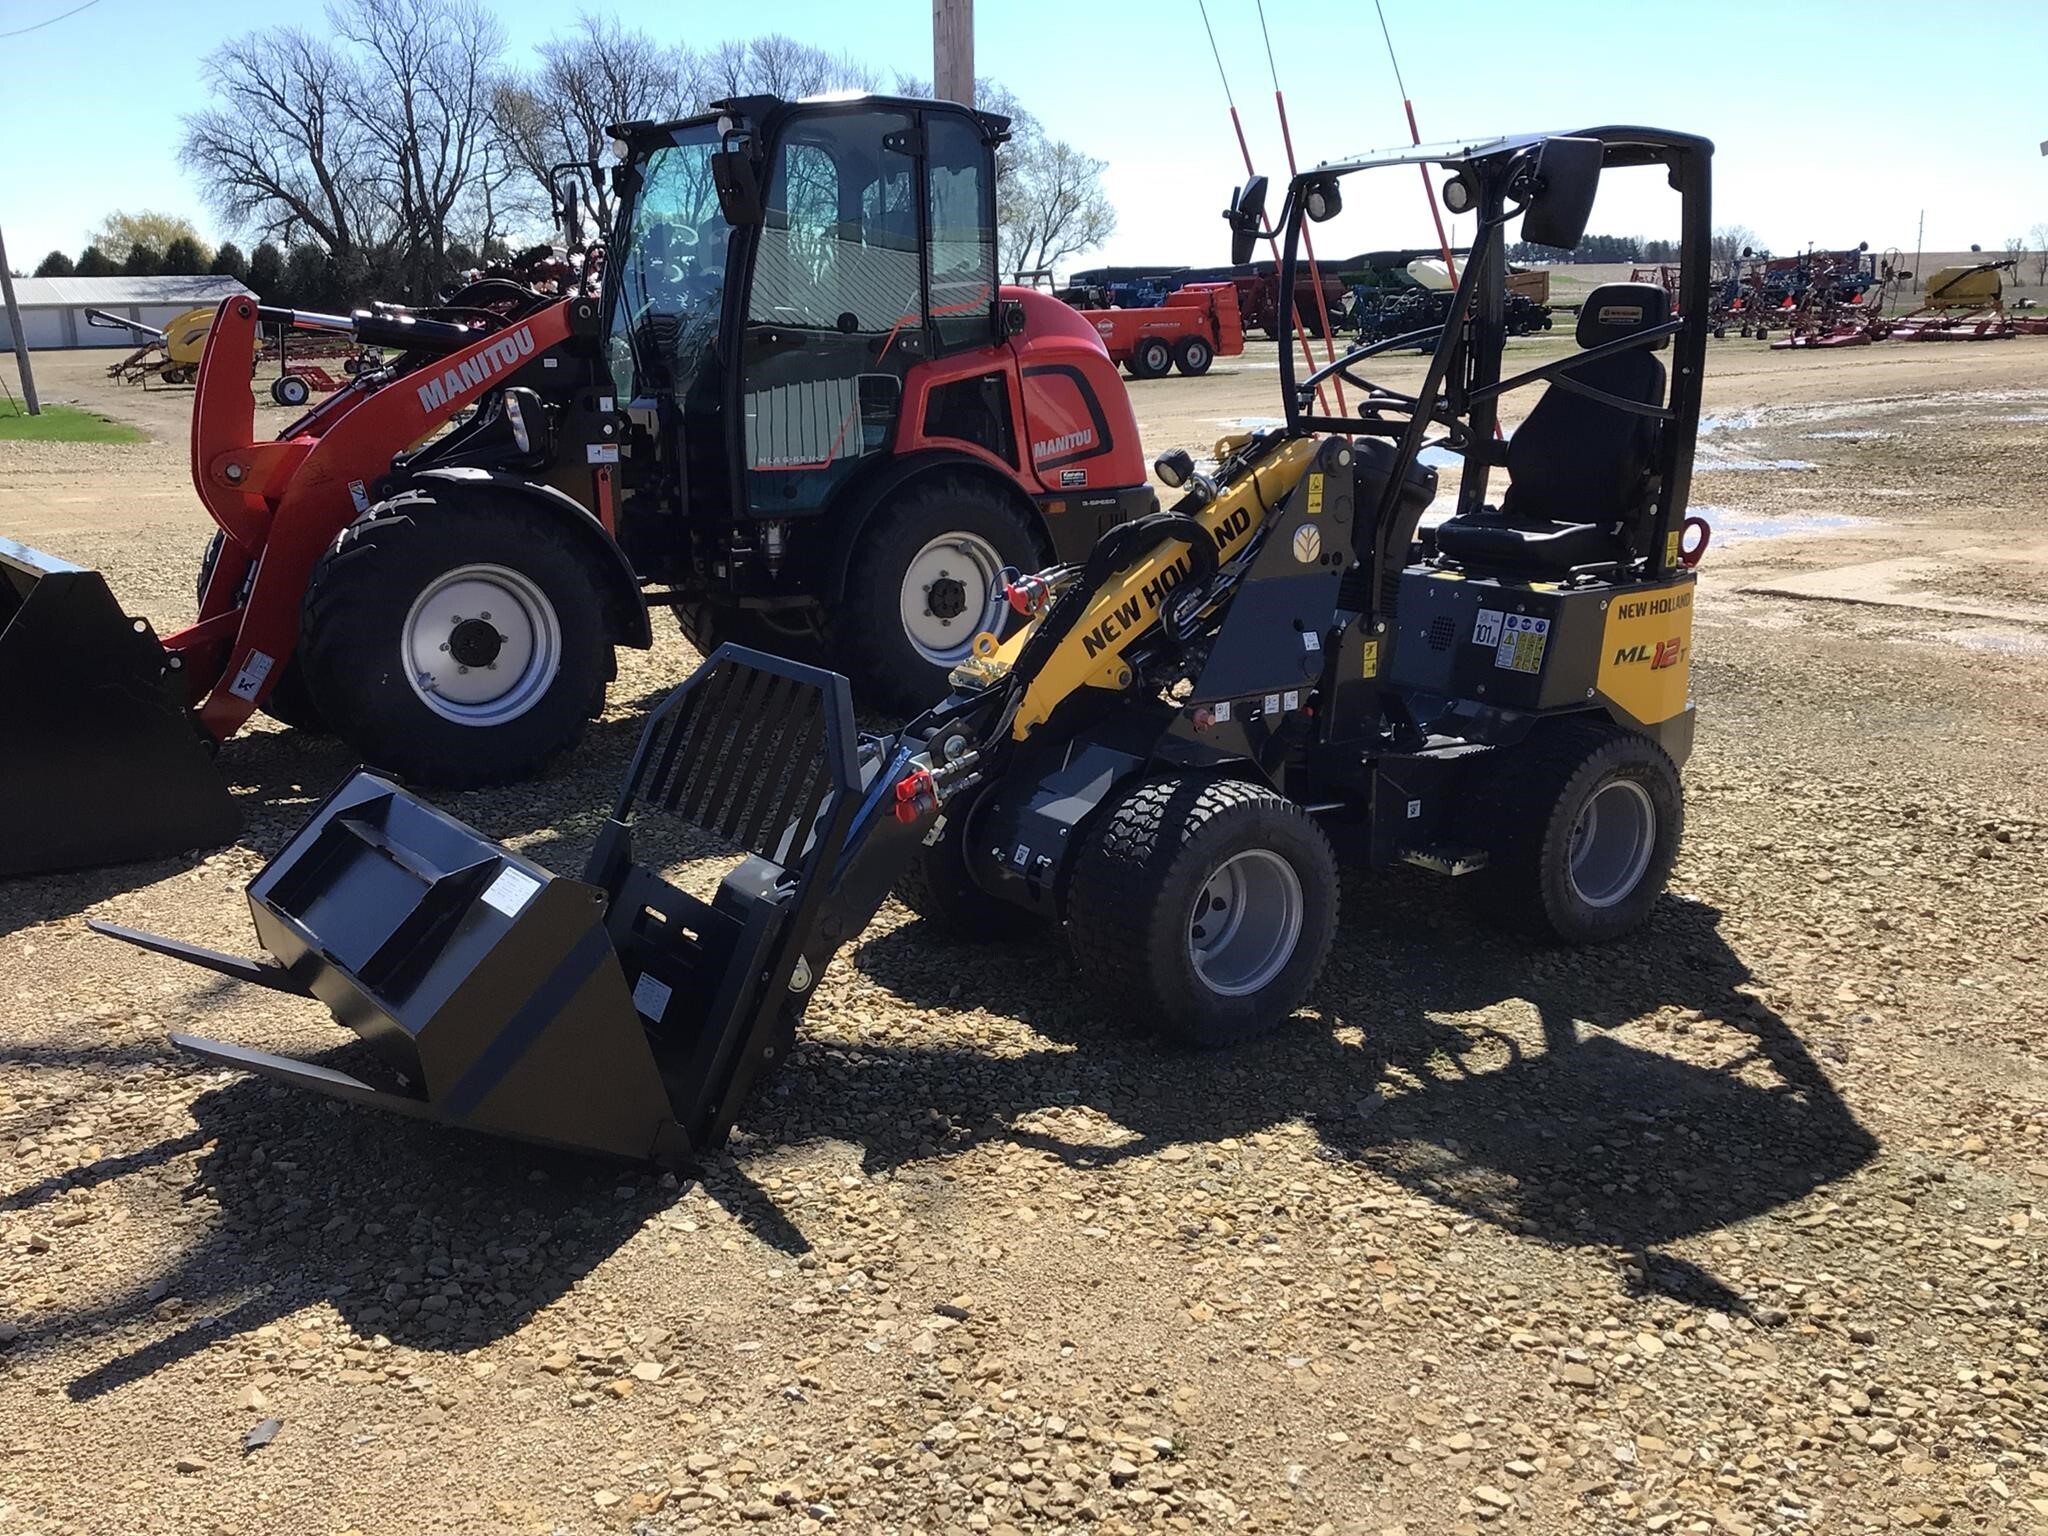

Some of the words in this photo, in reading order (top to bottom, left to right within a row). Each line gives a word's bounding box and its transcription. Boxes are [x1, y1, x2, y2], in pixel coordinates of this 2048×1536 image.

[416, 325, 535, 414] MANITOU
[1033, 429, 1092, 457] MANITOU
[1618, 601, 1648, 621] NEW
[1649, 592, 1691, 616] HOLLAND
[1081, 595, 1142, 660] NEW
[1476, 624, 1493, 644] 101
